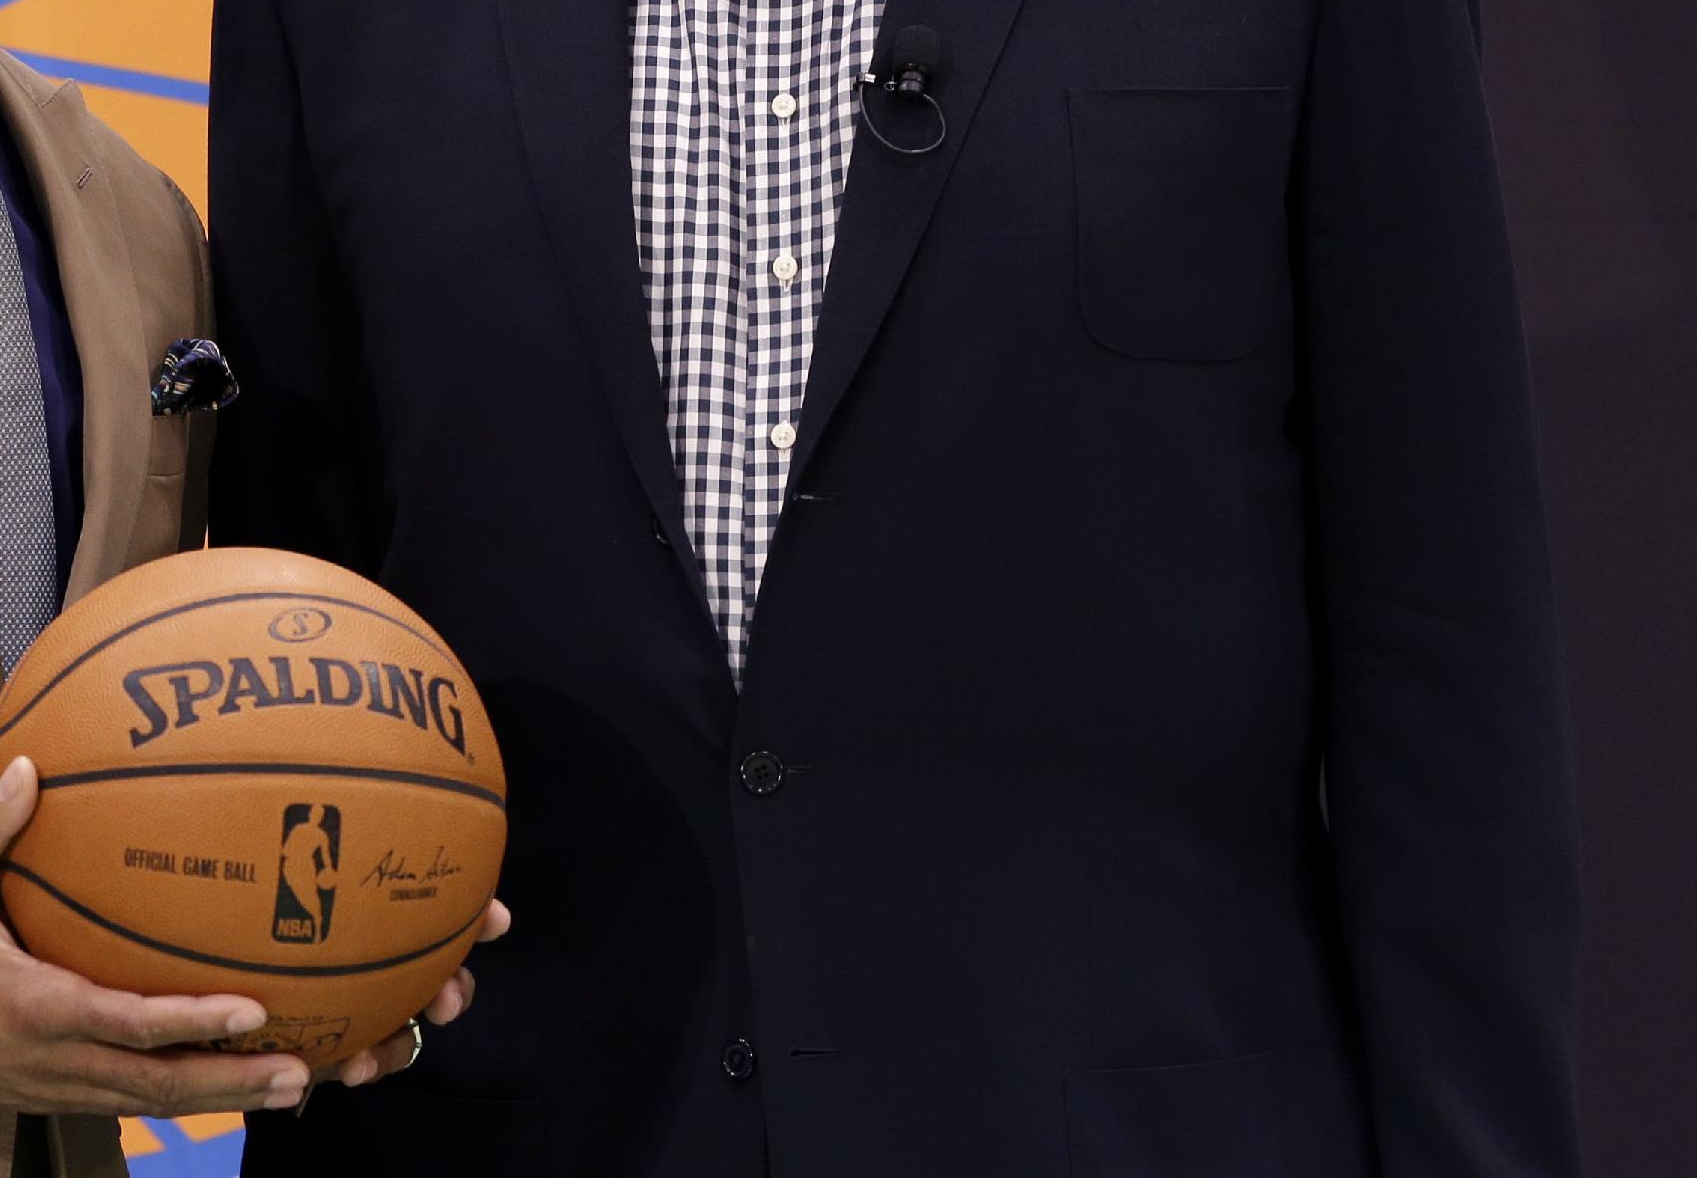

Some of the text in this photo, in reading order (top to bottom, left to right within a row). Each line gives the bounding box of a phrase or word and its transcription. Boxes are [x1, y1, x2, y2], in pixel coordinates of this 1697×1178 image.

[122, 655, 467, 757] SPALDING
[124, 847, 256, 883] OFFICIAL GAME BALL
[276, 917, 313, 938] NBA
